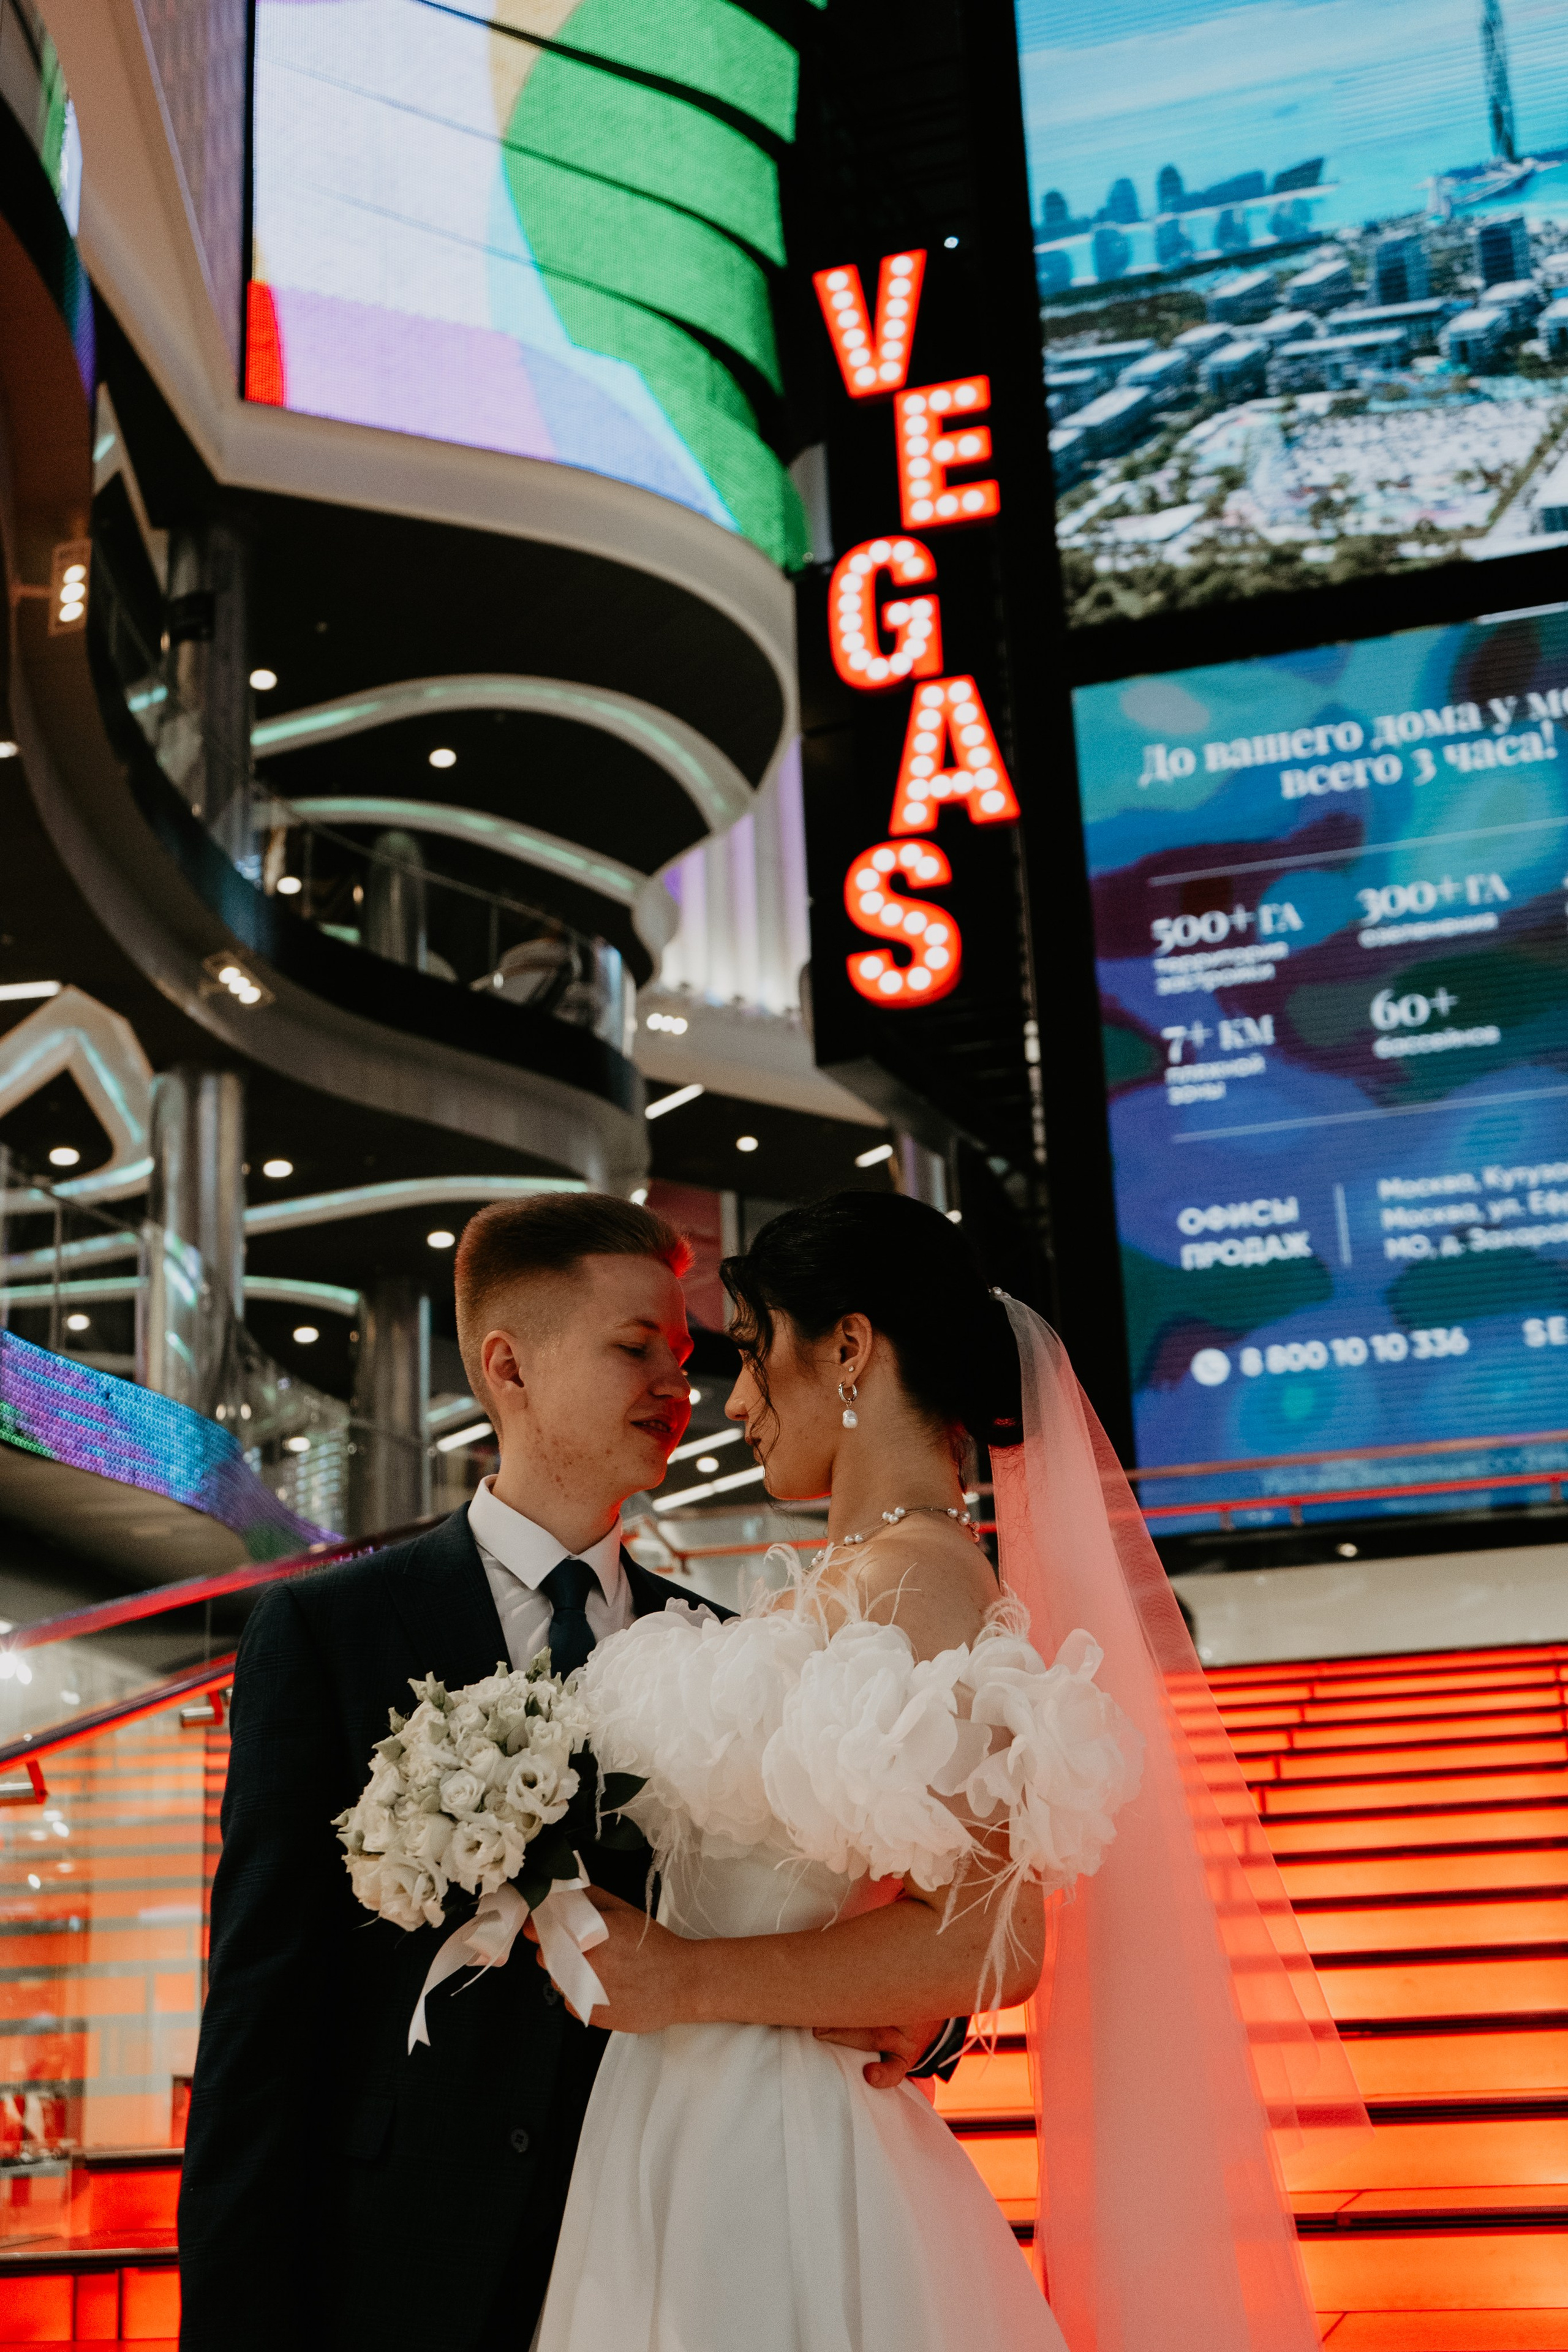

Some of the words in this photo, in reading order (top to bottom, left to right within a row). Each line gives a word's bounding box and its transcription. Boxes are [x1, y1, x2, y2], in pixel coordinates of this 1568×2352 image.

[813, 250, 1020, 1008] VEGAS
[1139, 743, 1196, 788] До
[1203, 721, 1364, 772] вашего
[1370, 702, 1483, 752] дома
[1488, 695, 1517, 735] у
[1526, 688, 1568, 722] м
[1281, 754, 1403, 799] всего
[1411, 748, 1437, 786] 3
[1442, 719, 1558, 773] часа!
[1355, 874, 1463, 927] 300+
[1151, 903, 1256, 957] 500+
[1370, 986, 1460, 1030] 60+
[1161, 1020, 1214, 1064] 7+
[1177, 1196, 1299, 1235] ОФИСЫ
[1180, 1230, 1312, 1271] ПРОДАЖ
[1240, 1347, 1264, 1378] 8
[1265, 1340, 1329, 1374] 800
[1330, 1336, 1368, 1366] 10
[1370, 1332, 1408, 1362] 10
[1410, 1327, 1469, 1359] 336
